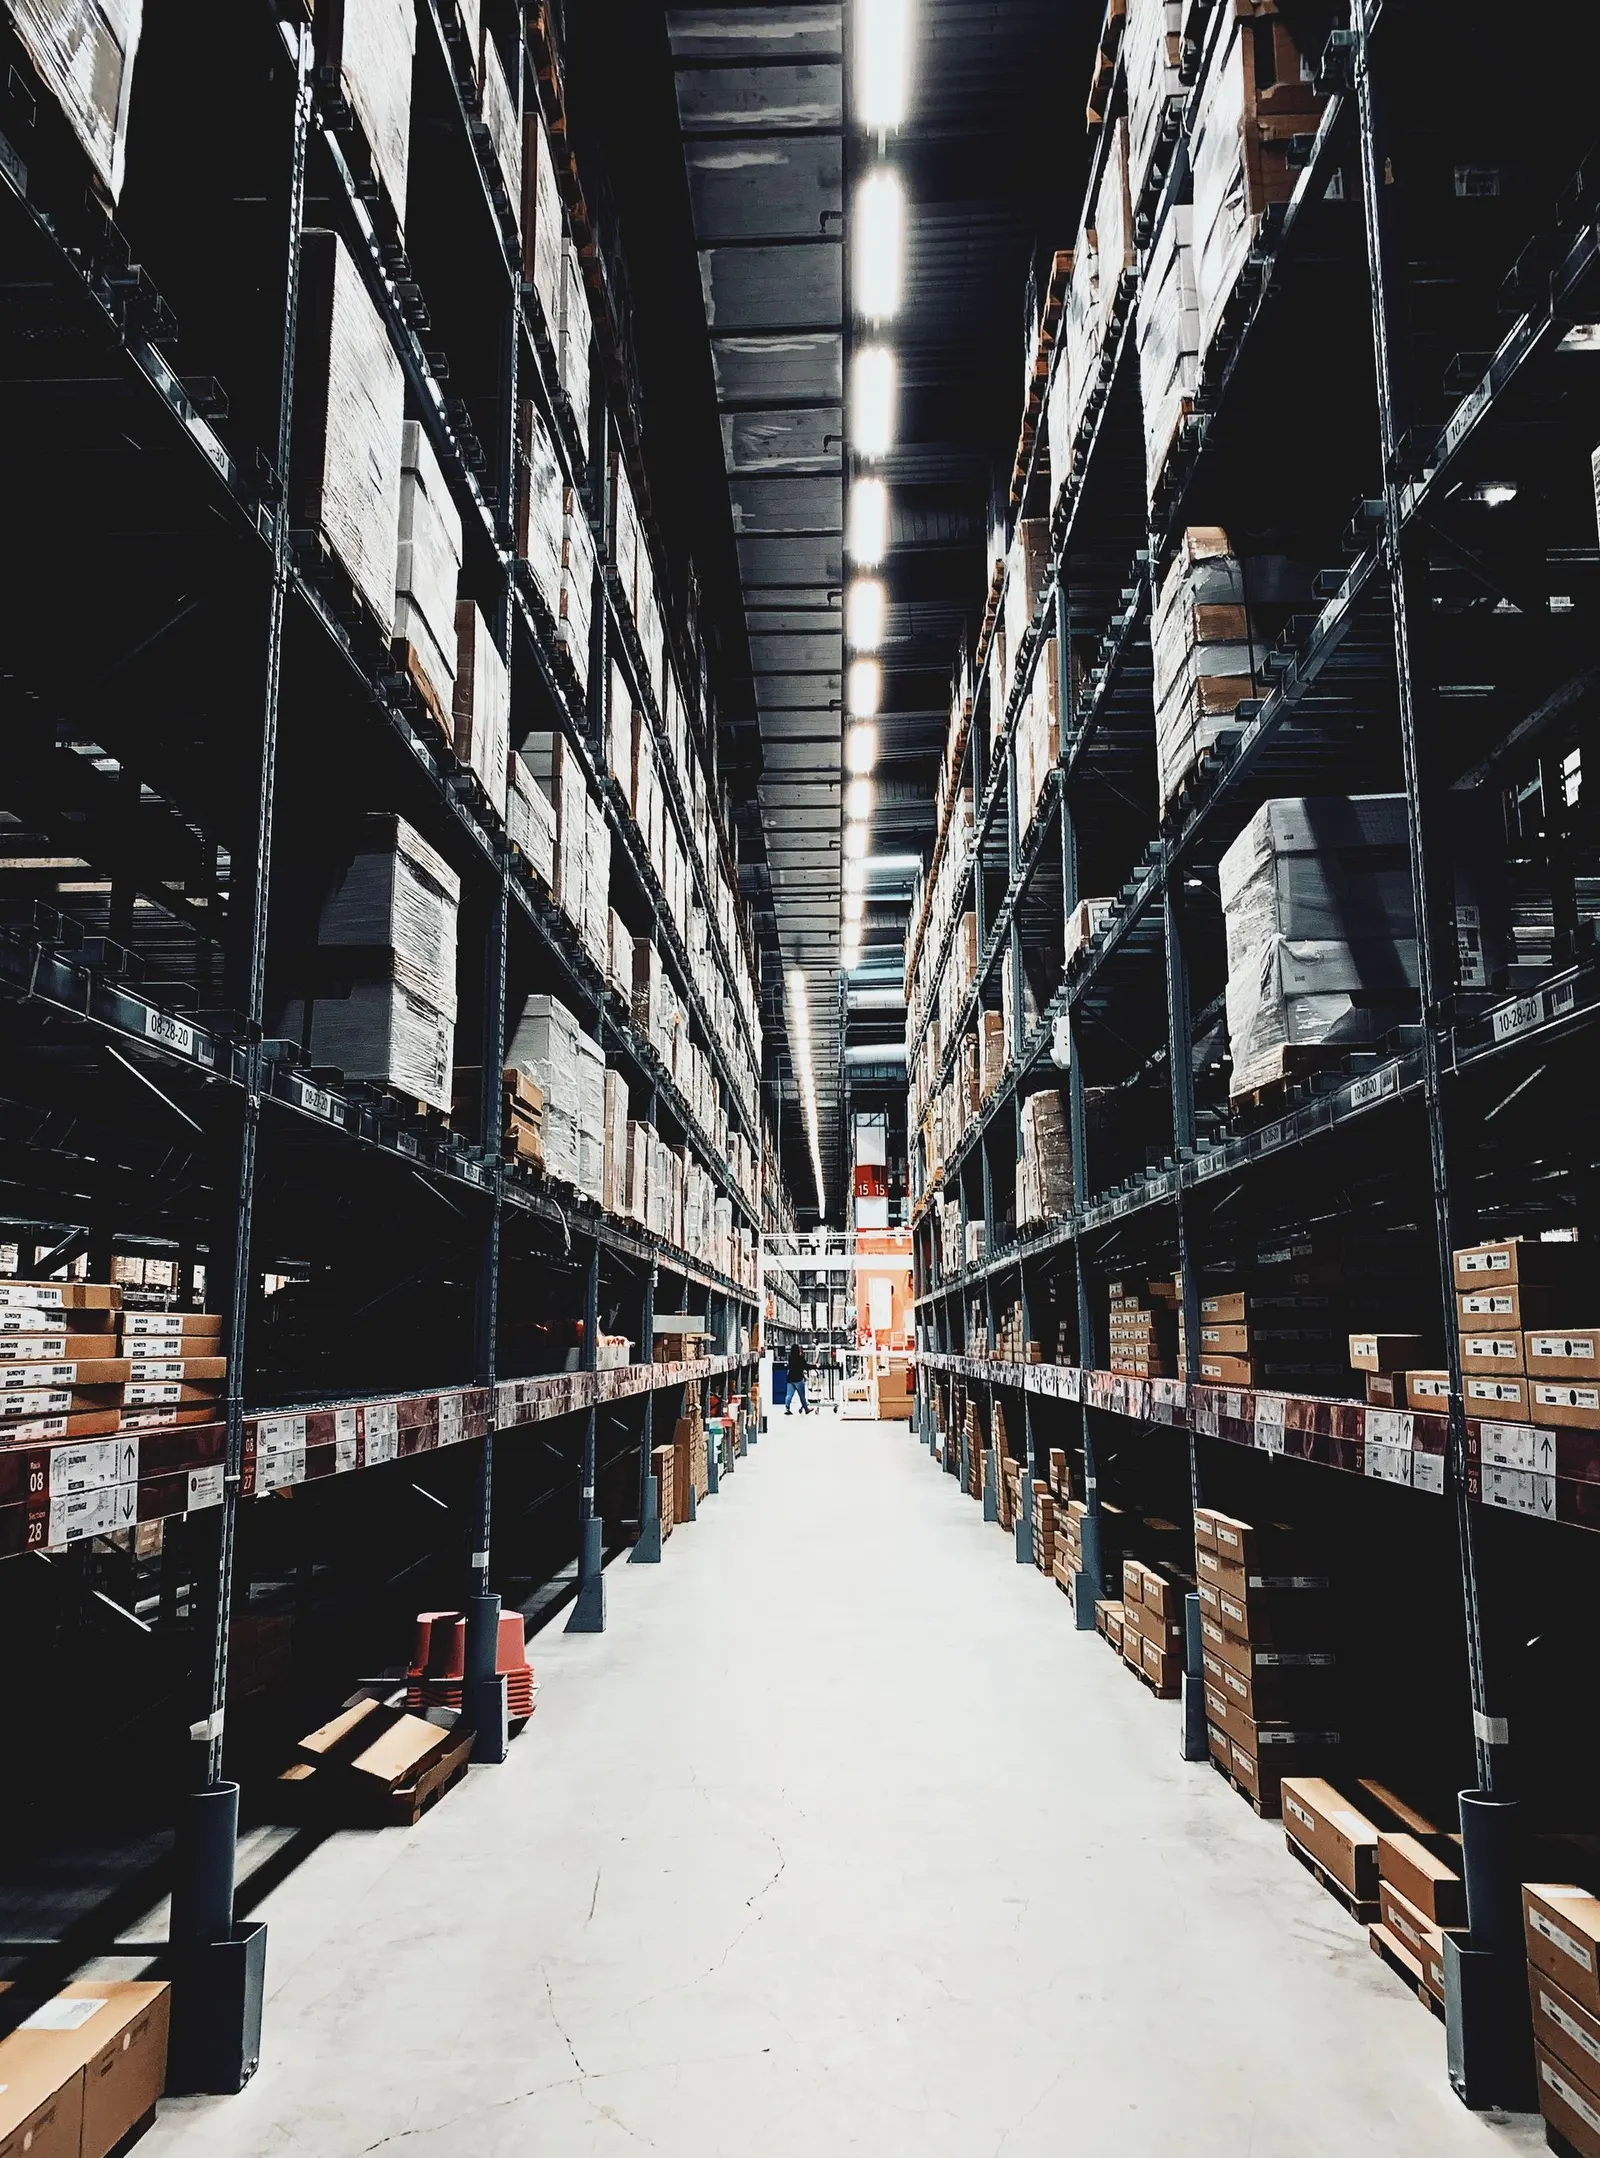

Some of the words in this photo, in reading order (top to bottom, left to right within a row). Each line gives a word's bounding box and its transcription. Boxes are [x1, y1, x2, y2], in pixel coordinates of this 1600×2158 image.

[1499, 1001, 1538, 1031] 10-28-20
[151, 1014, 188, 1046] 08-28-20
[1354, 1077, 1377, 1100] 10-27-20
[305, 1088, 328, 1112] 08-27-20
[859, 1184, 869, 1195] 15
[875, 1184, 885, 1195] 15
[1468, 1439, 1477, 1454] 10
[30, 1472, 44, 1491] 08
[244, 1475, 253, 1489] 27
[1468, 1478, 1478, 1494] 28
[28, 1522, 42, 1543] 28
